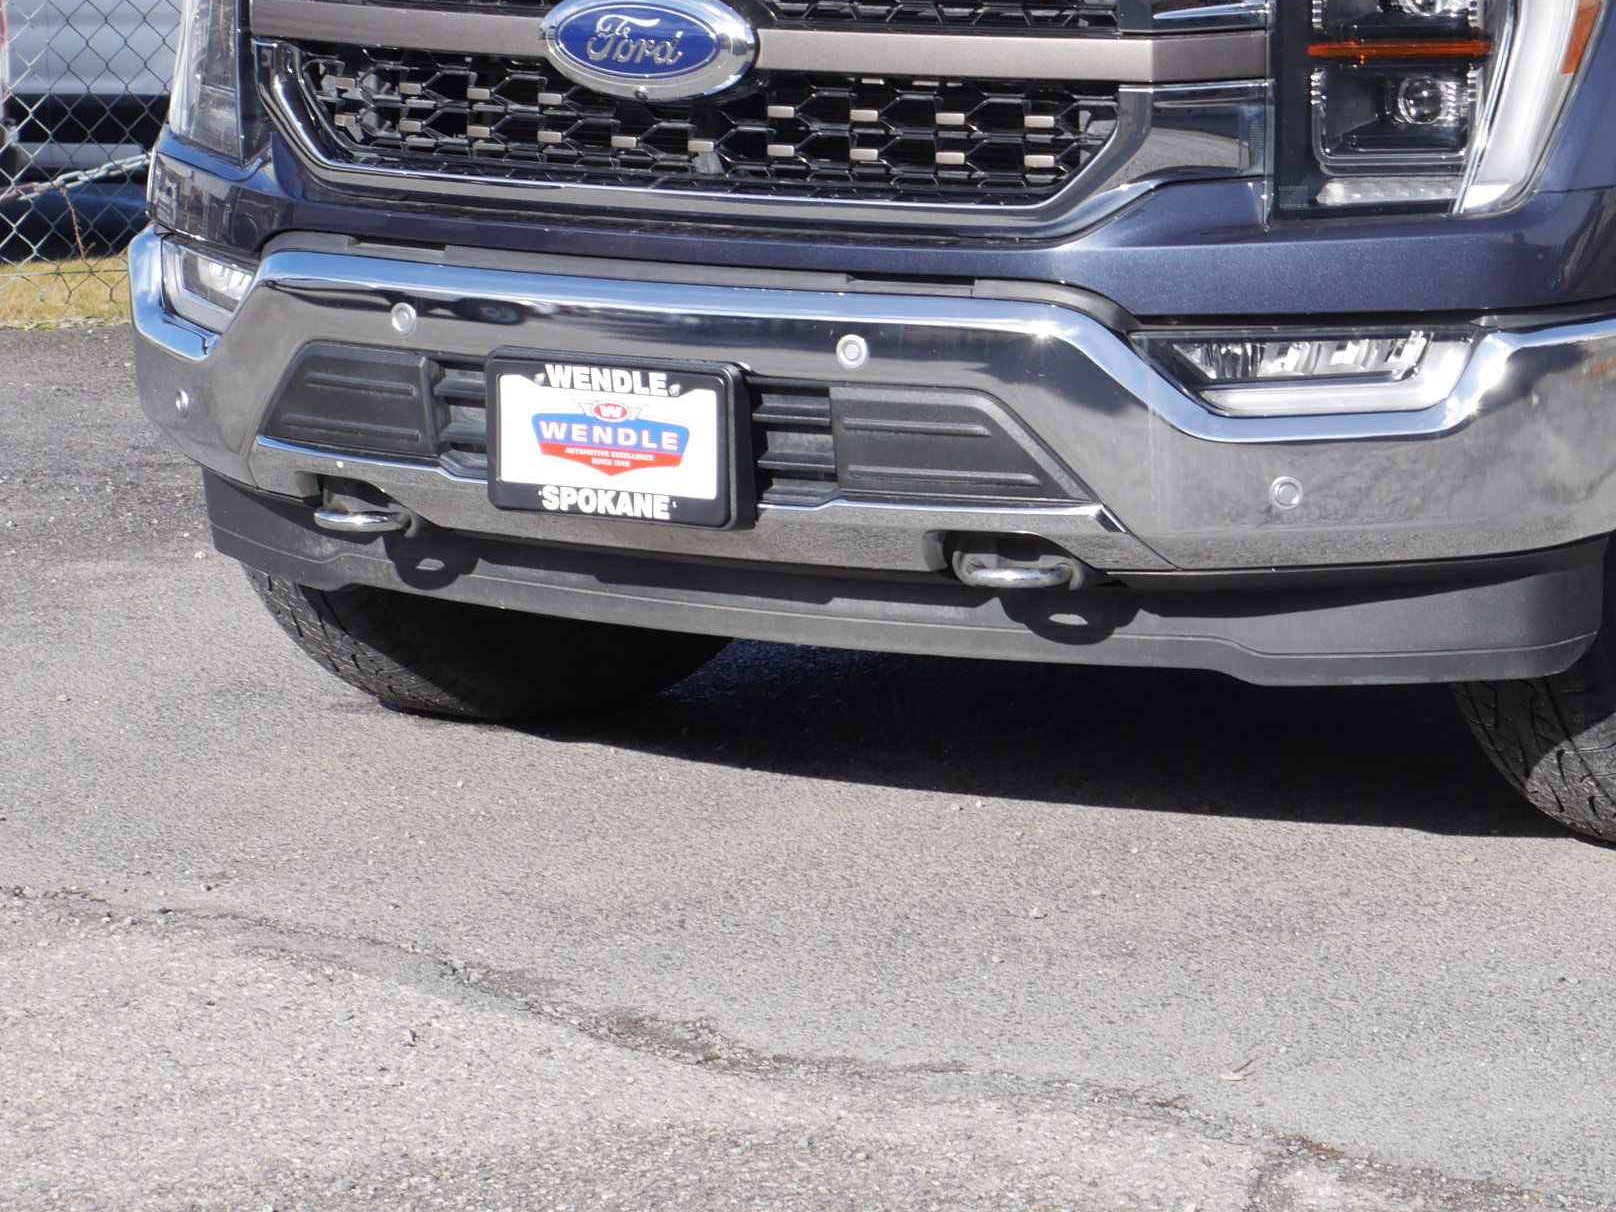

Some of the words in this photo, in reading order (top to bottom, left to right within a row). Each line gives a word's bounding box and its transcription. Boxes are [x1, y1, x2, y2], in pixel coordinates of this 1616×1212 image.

[586, 14, 684, 66] Ford
[544, 363, 669, 397] WENDLE
[539, 421, 679, 451] WENDLE
[565, 447, 610, 458] AUTOMOTIVE
[611, 451, 655, 462] EXCELLENCE
[591, 457, 613, 466] SINCE
[541, 485, 670, 520] SPOKANE
